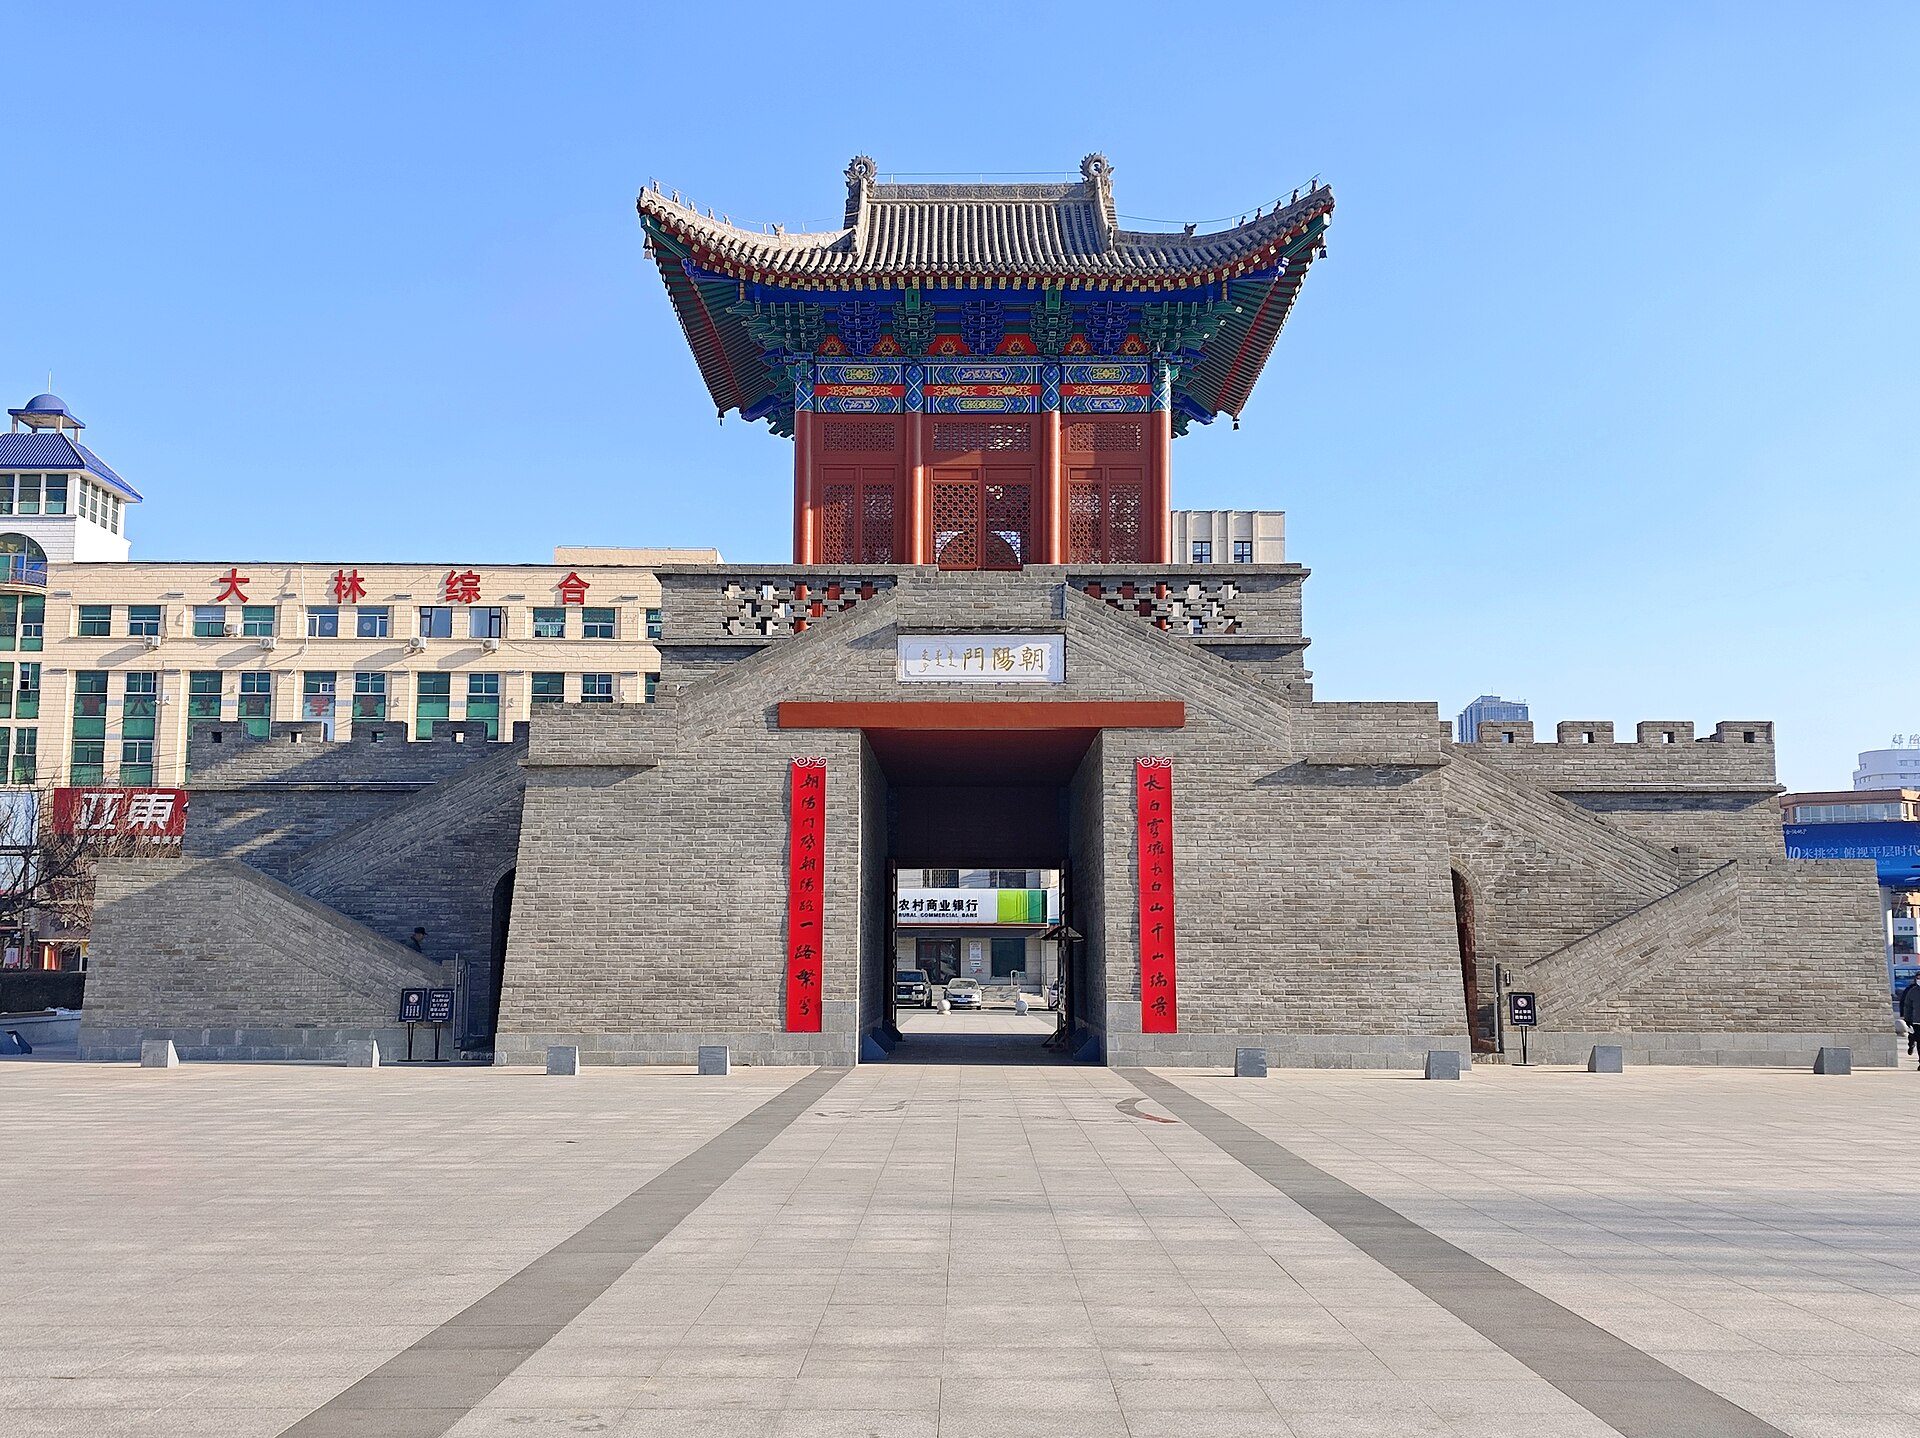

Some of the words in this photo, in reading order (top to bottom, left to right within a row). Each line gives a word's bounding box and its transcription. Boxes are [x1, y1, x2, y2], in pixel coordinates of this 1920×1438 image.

[216, 568, 591, 605] 大林综合
[79, 793, 188, 830] 亚東
[1843, 844, 1919, 858] 俯视平层时代
[898, 898, 978, 911] 农村商业银行
